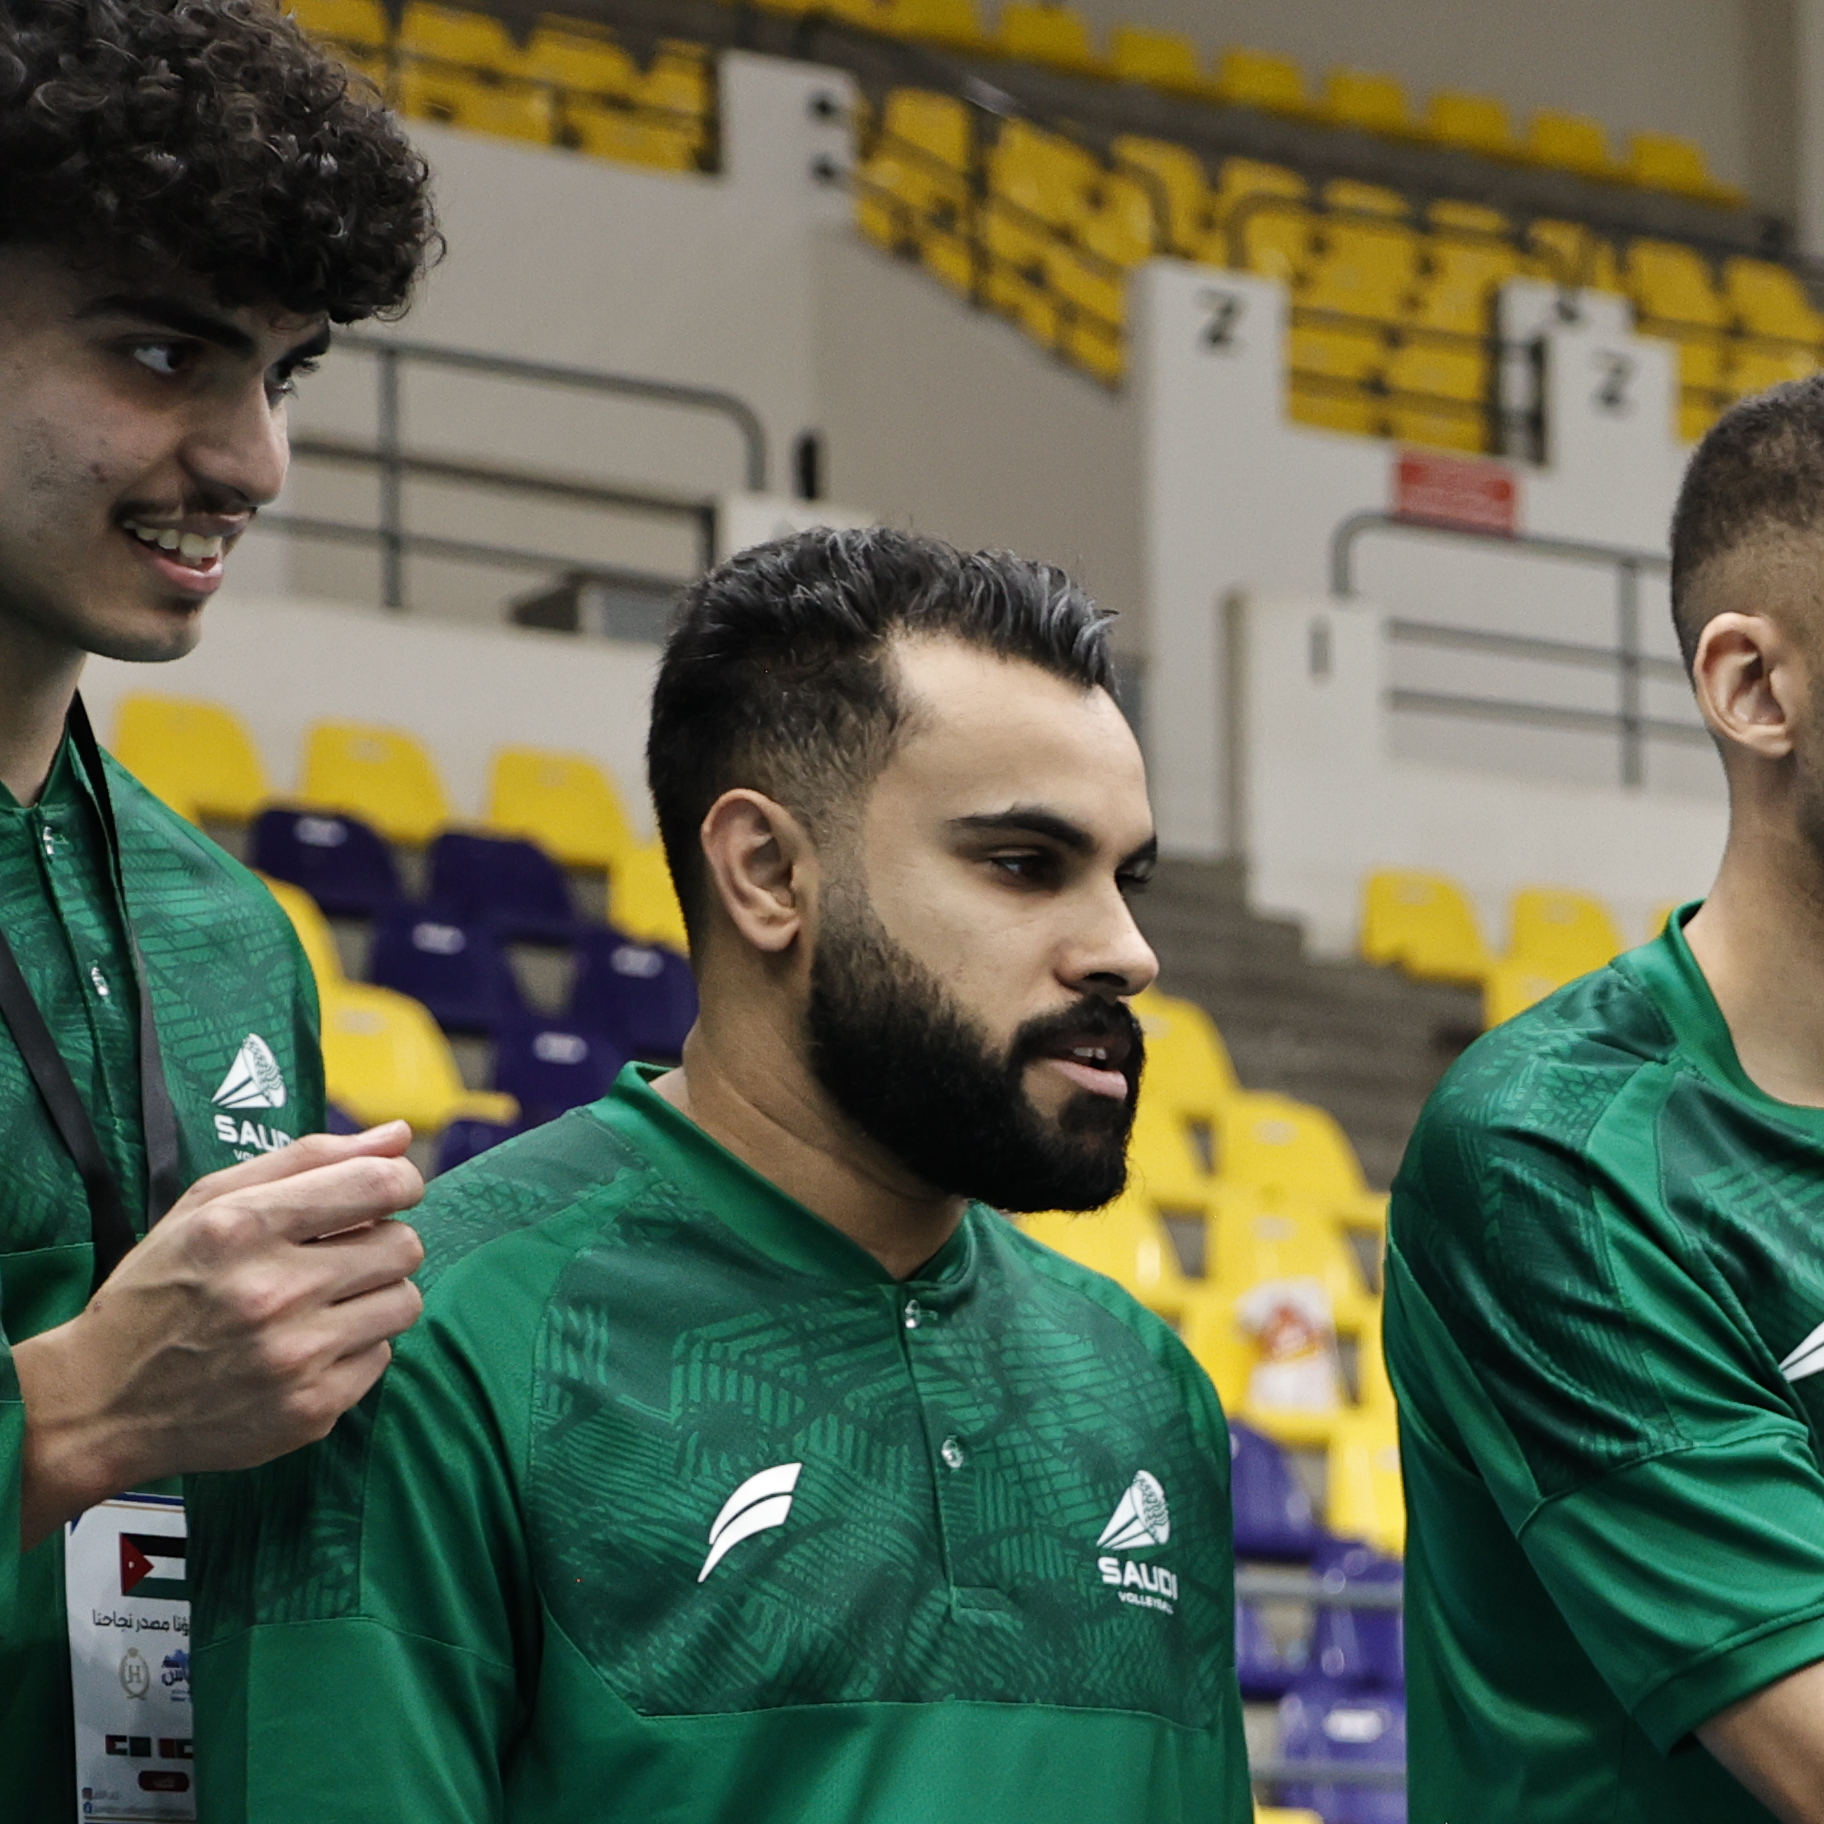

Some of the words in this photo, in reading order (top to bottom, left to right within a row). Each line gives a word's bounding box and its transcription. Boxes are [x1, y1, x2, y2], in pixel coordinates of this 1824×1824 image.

[1097, 1556, 1179, 1601] SAUDI
[92, 1608, 133, 1633] نجاحنا
[135, 1616, 170, 1633] مصدر
